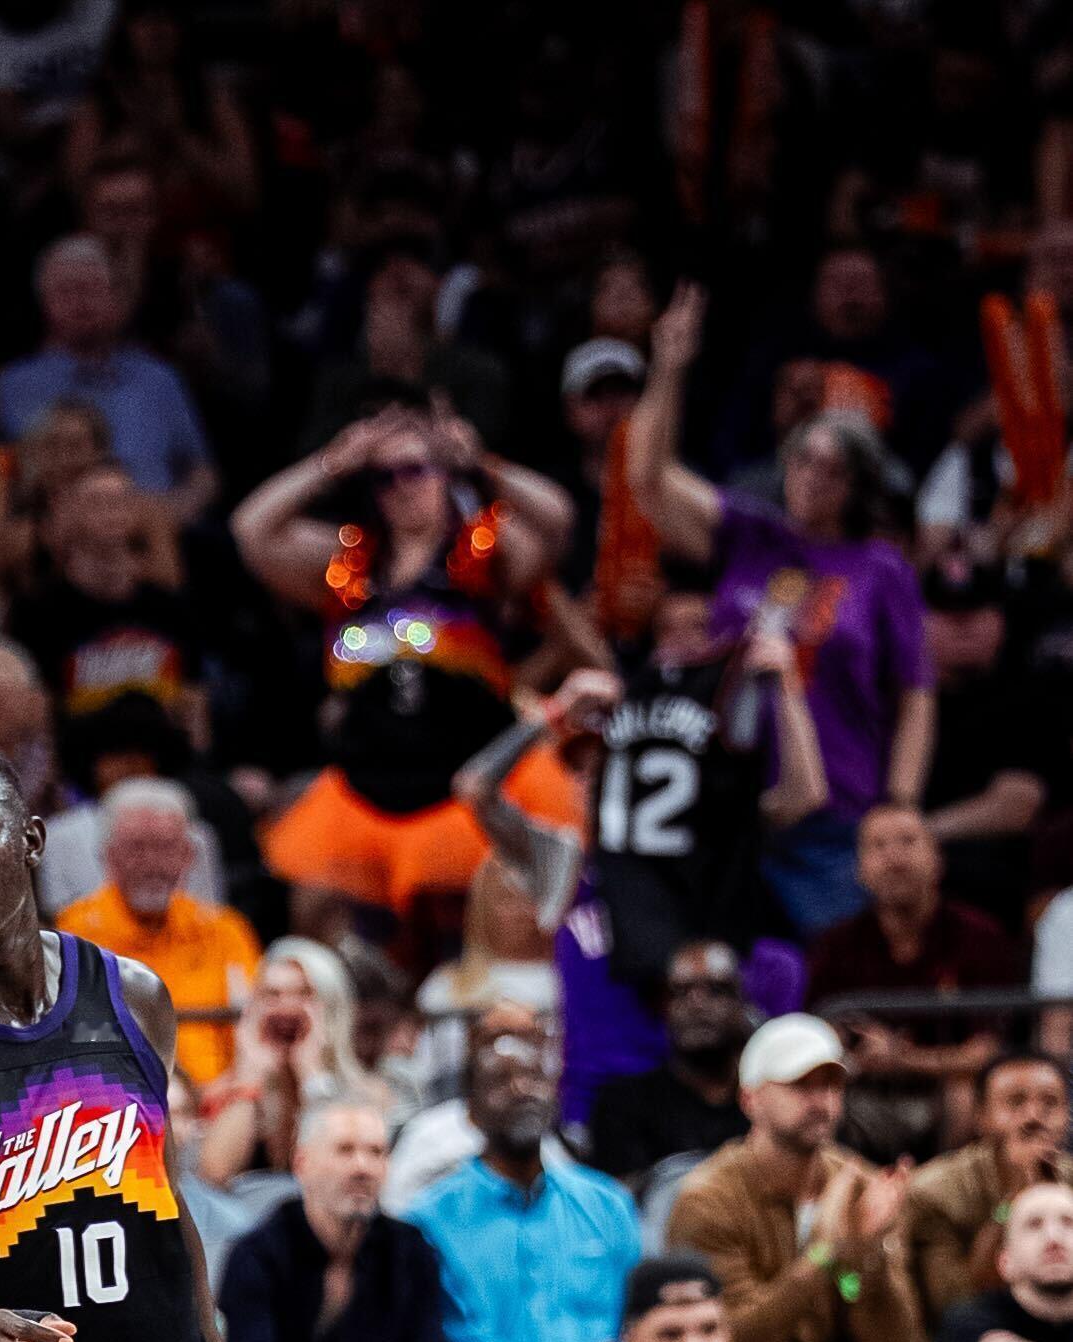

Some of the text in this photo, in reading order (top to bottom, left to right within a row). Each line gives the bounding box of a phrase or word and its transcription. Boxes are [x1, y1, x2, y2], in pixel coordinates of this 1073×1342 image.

[599, 749, 700, 857] 12
[3, 1127, 37, 1156] THE
[55, 1220, 129, 1308] 10
